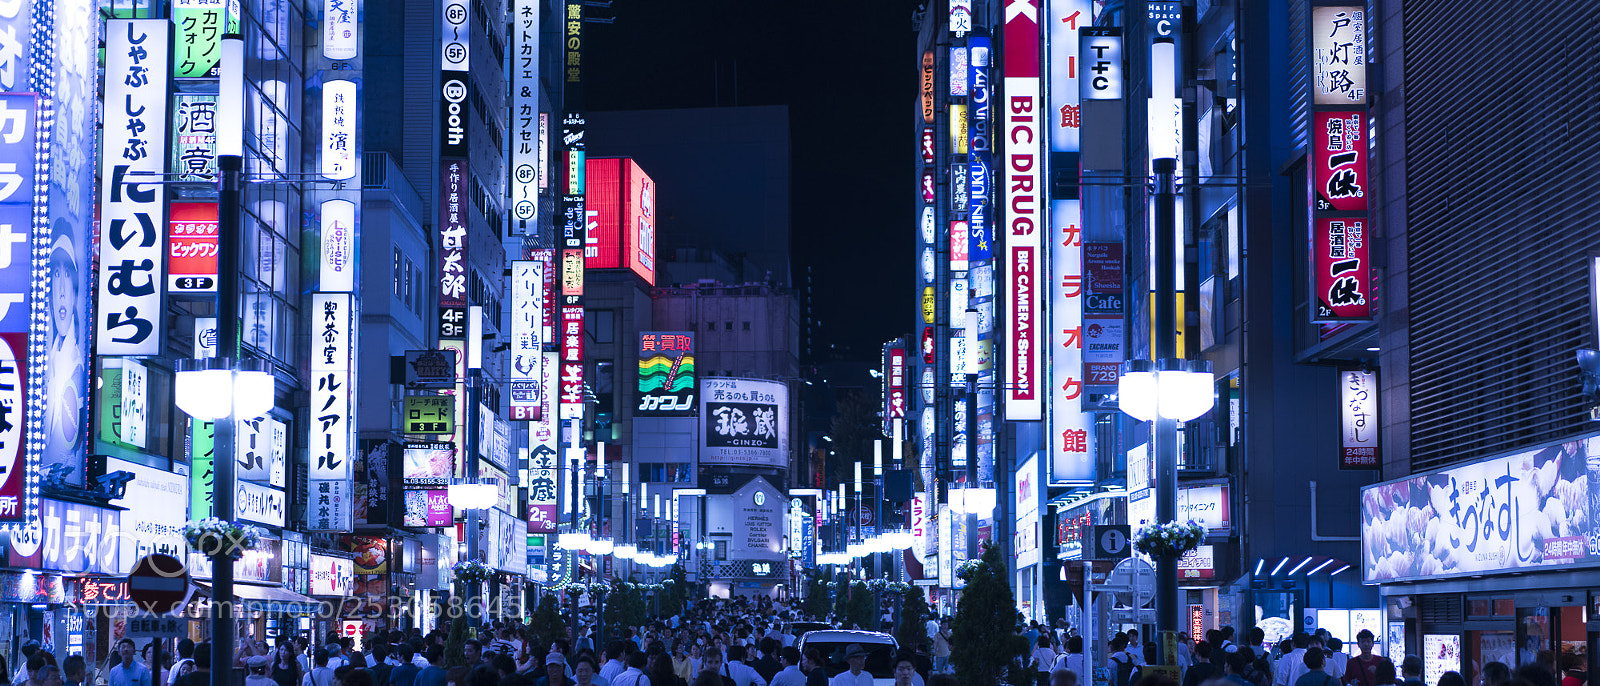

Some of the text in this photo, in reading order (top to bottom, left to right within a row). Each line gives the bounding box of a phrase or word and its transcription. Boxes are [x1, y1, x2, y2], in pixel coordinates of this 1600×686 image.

[1147, 12, 1180, 20] Space
[1156, 20, 1171, 36] C
[180, 16, 198, 75] クォーク
[567, 4, 581, 83] 驚安の殿堂
[1350, 11, 1363, 66] 個室居酒屋
[1328, 13, 1354, 94] 戸灯路
[519, 5, 533, 154] ネットカフェ & カプセル
[122, 21, 150, 162] しゃぶしゃぶ
[1347, 88, 1364, 100] 4F
[442, 79, 468, 146] Booth
[1327, 118, 1343, 151] 焼鳥
[1010, 95, 1035, 236] BIC DRUG
[1326, 151, 1361, 199] 一休
[449, 163, 460, 224] 手作り居酒屋
[1317, 200, 1330, 211] 3F
[574, 203, 584, 231] Castle
[174, 223, 218, 235] カラオケ
[1329, 221, 1345, 258] 居酒屋
[106, 164, 157, 345] にいむら
[170, 242, 218, 258] ビックワン
[440, 224, 467, 299] 甘太郎
[1017, 250, 1029, 273] BIC
[184, 278, 206, 289] 3F
[1328, 259, 1363, 308] 一休
[566, 296, 580, 304] 6F
[1085, 294, 1121, 309] Cafe
[442, 308, 464, 323] 4F
[1318, 307, 1331, 317] 2F
[441, 323, 464, 336] 3F
[641, 335, 692, 352] 質・買取
[1089, 343, 1120, 351] EXCHANGE
[705, 381, 736, 389] ブランド品
[1091, 371, 1117, 382] 729
[410, 398, 448, 406] リーチ麻雀
[638, 394, 694, 411] カワノ
[318, 372, 343, 471] ルノアール
[409, 408, 449, 420] ロード
[515, 407, 535, 420] B1
[419, 422, 439, 431] 3F
[1344, 456, 1377, 465] 年中無休
[1346, 448, 1375, 456] 24時間
[529, 443, 556, 502] 金の蔵
[318, 481, 331, 530] 磯丸水産
[1449, 461, 1534, 562] きづなすし
[913, 496, 922, 537] トラノコ
[43, 506, 120, 567] カラオケ
[551, 541, 562, 582] カラオケ
[130, 619, 184, 633] 自転車を除く
